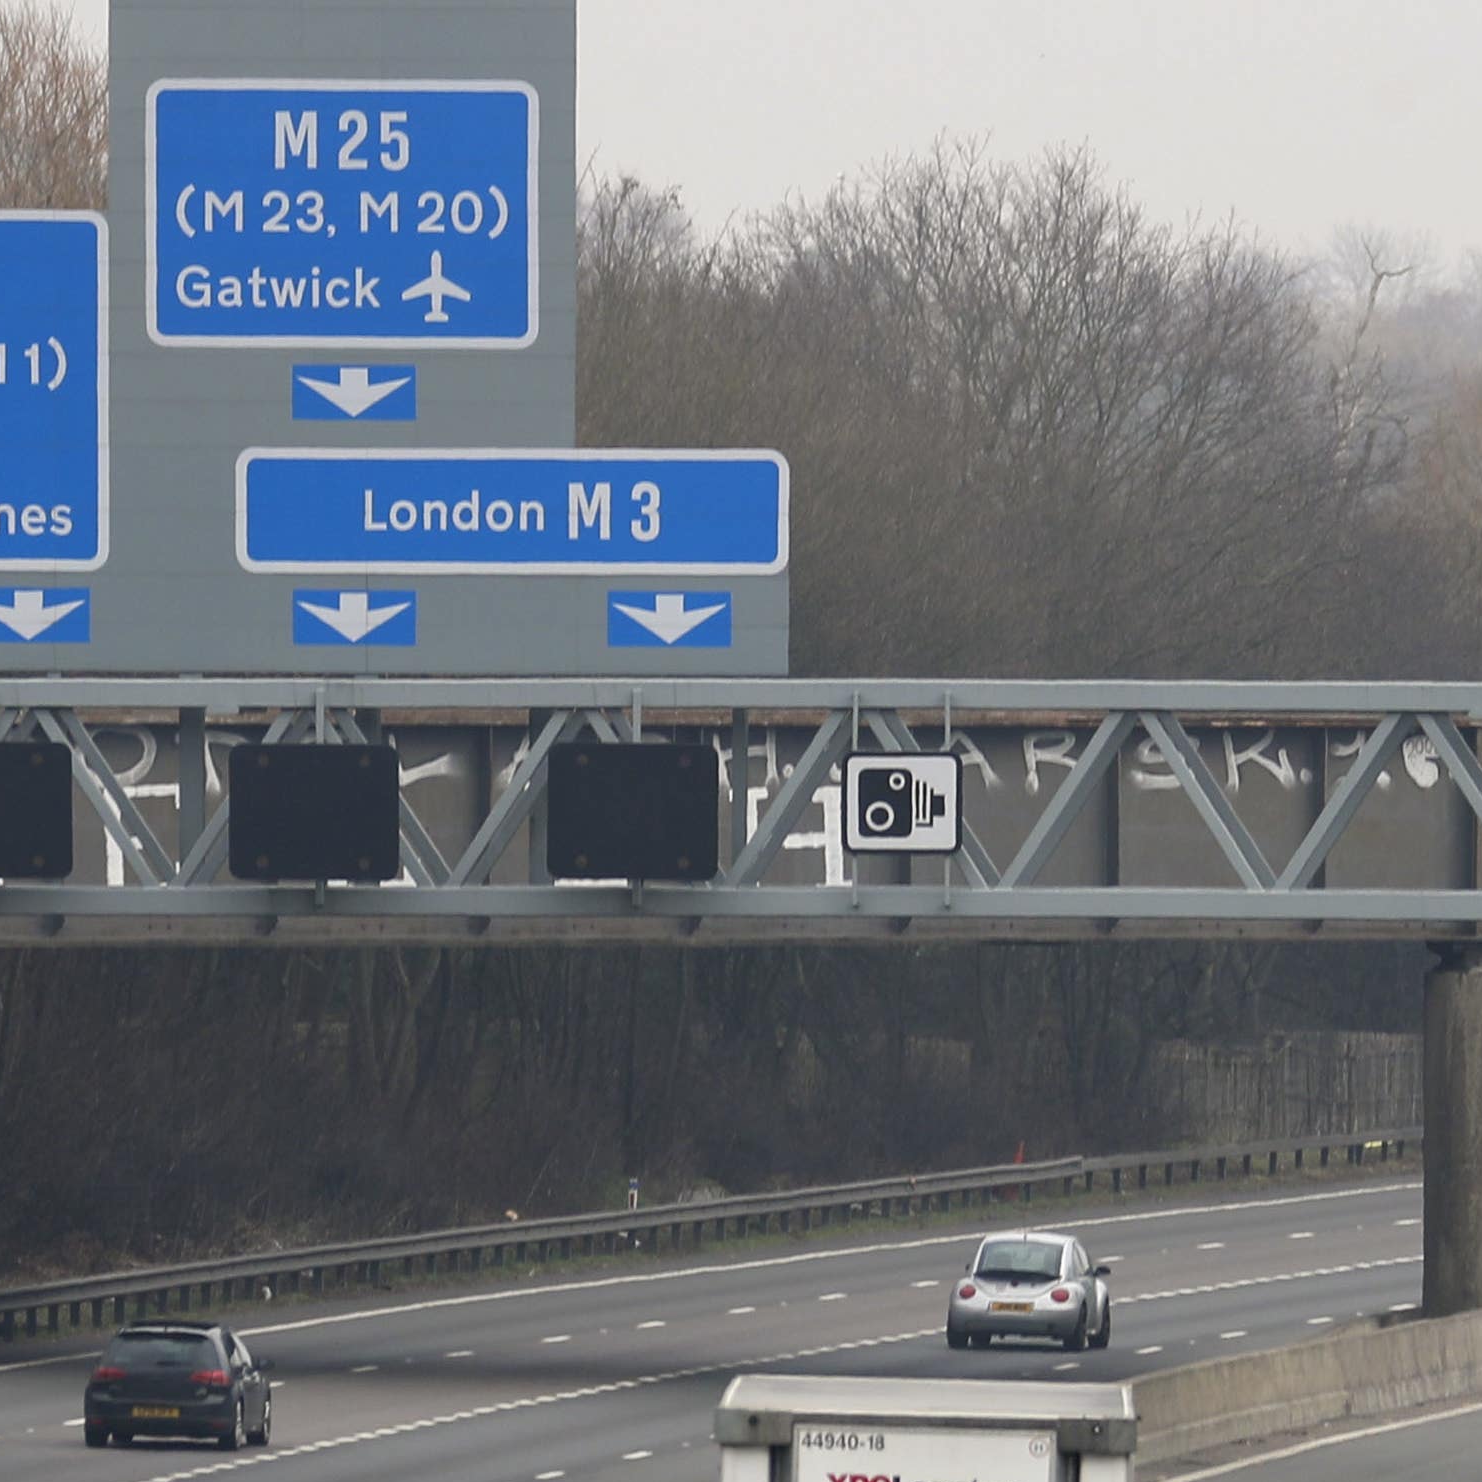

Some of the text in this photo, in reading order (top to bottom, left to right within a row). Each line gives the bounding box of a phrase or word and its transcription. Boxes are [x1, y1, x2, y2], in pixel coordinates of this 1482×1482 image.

[176, 265, 381, 308] Gatwick
[364, 489, 545, 532] London
[801, 1433, 886, 1451] 44940-18
